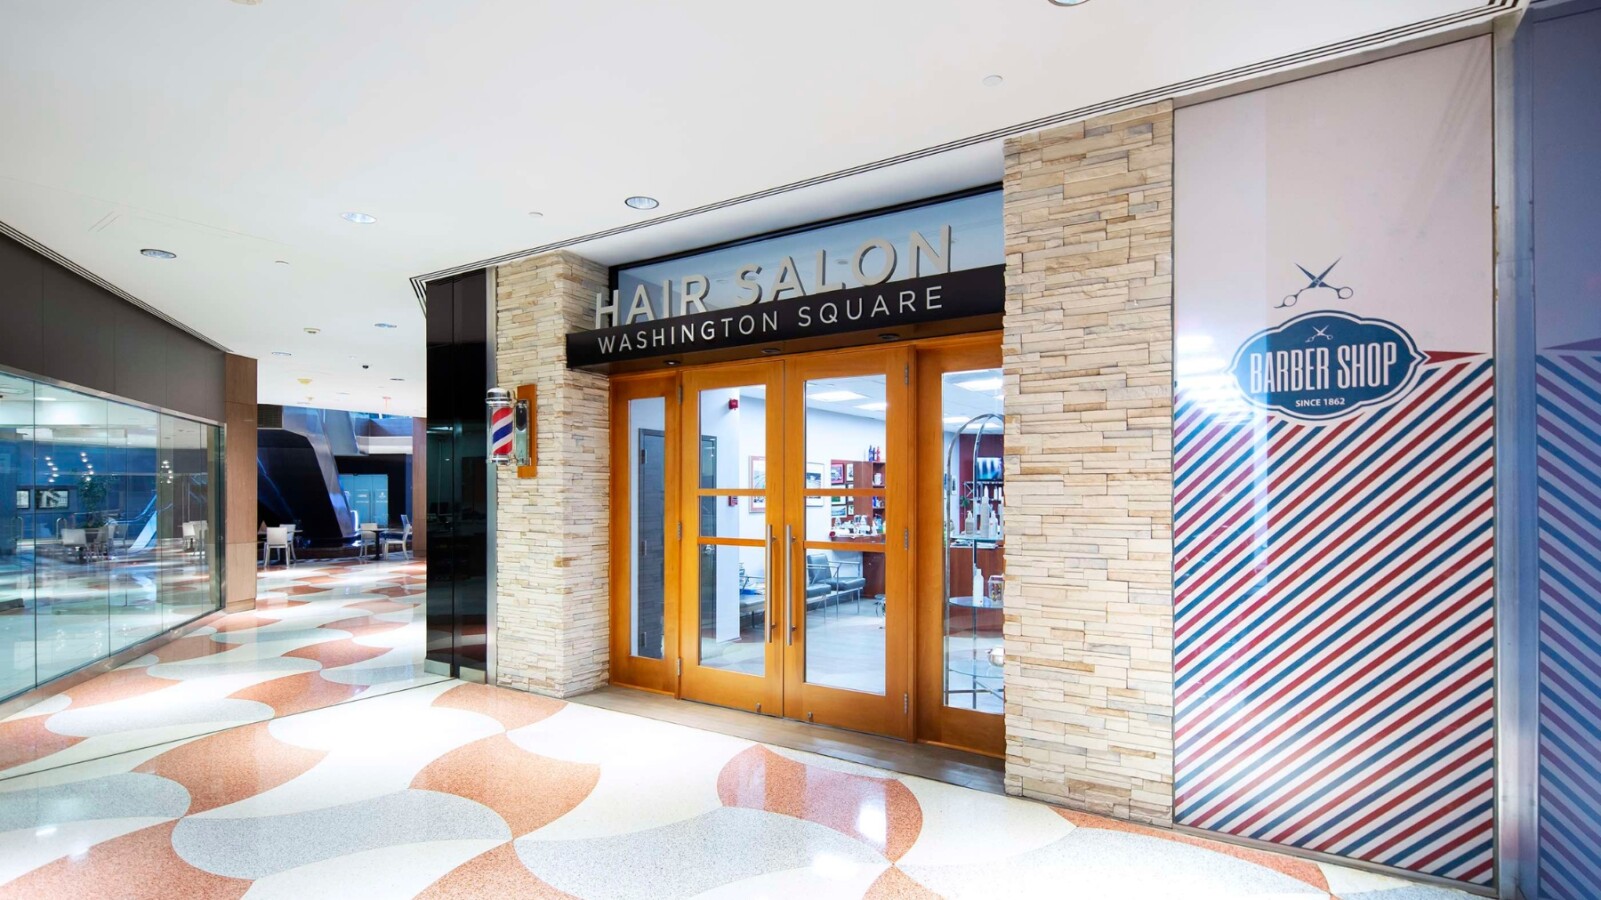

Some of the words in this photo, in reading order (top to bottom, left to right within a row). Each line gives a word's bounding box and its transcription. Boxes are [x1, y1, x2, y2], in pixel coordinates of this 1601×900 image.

[595, 275, 710, 328] HAIR
[736, 225, 953, 306] SALON
[598, 311, 778, 354] WASHINGTON
[798, 286, 942, 327] SQUARE
[1250, 347, 1329, 393] BARBER
[1337, 341, 1397, 389] SHOP
[1295, 399, 1321, 407] SINCE
[1323, 397, 1345, 406] 1862
